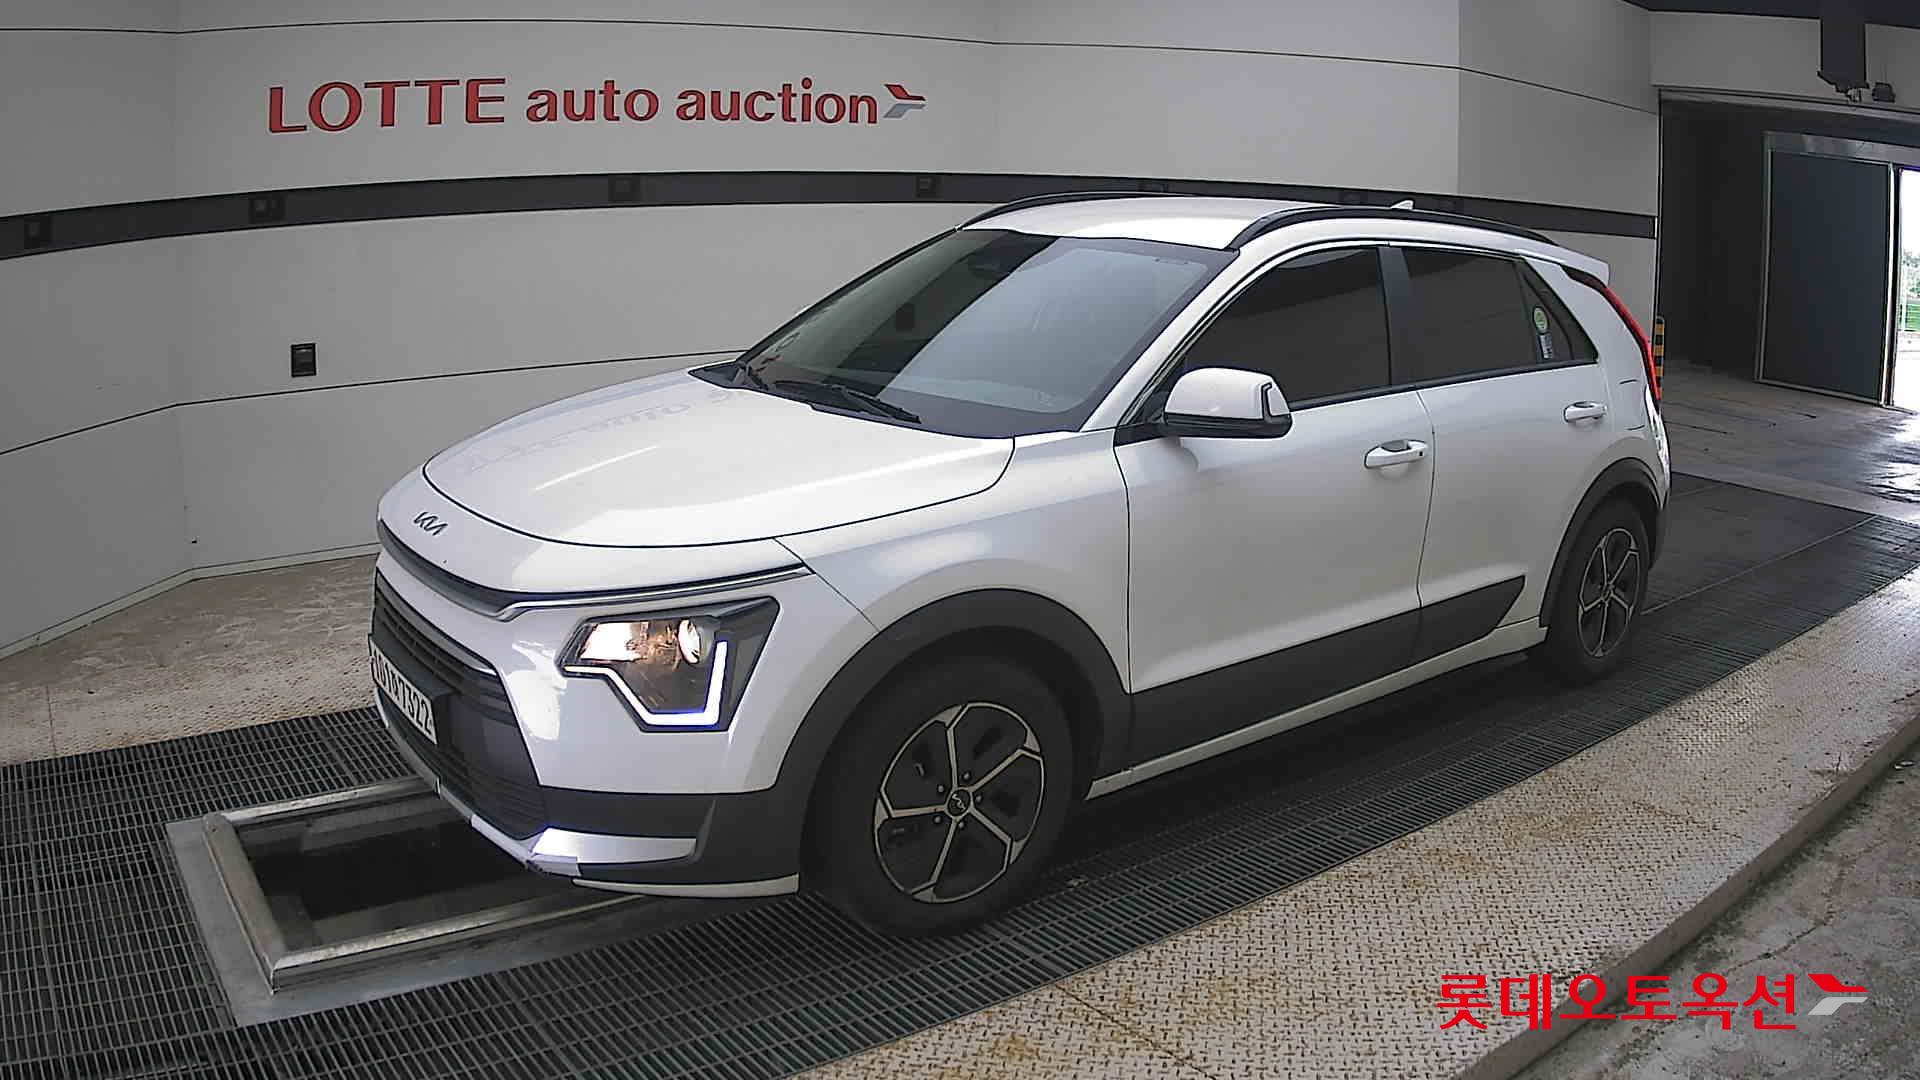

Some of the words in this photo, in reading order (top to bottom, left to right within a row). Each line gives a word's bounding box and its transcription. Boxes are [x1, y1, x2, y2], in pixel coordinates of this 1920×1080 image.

[268, 77, 507, 133] LOTTE
[525, 79, 660, 122] auto
[674, 77, 879, 124] auction
